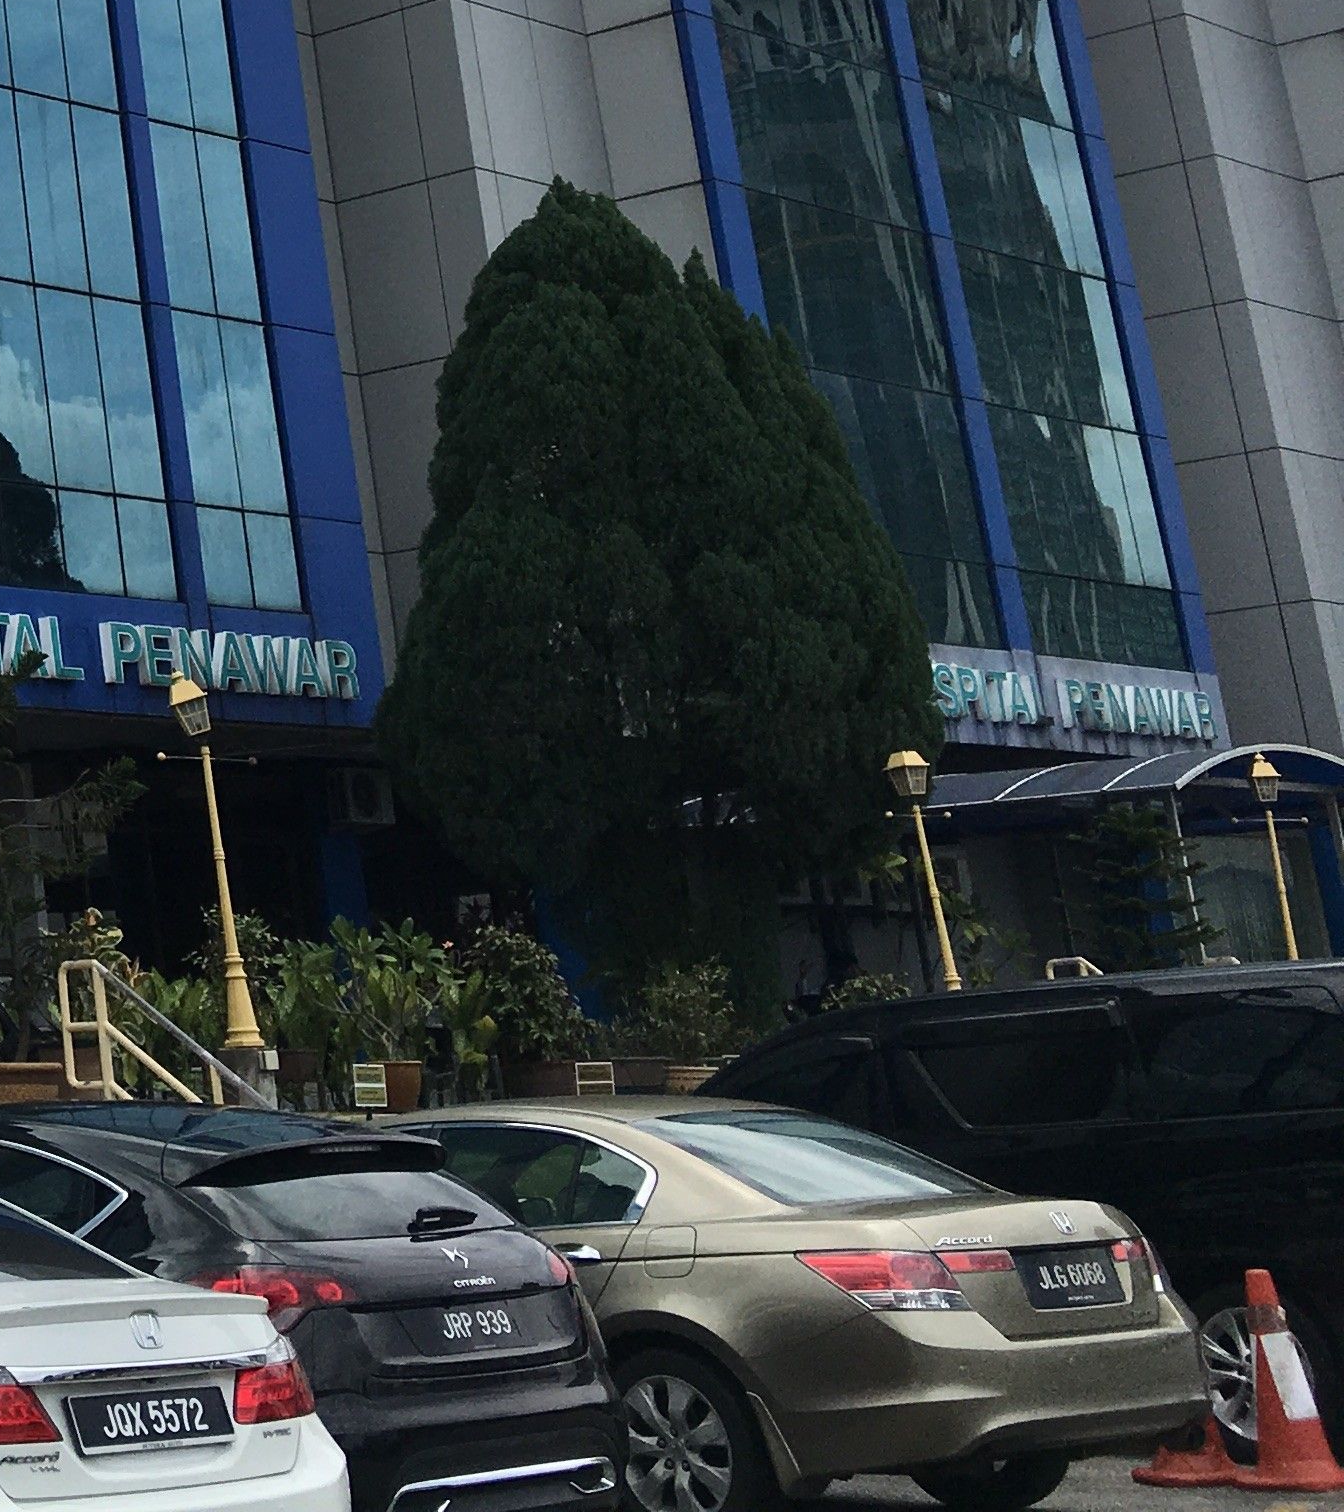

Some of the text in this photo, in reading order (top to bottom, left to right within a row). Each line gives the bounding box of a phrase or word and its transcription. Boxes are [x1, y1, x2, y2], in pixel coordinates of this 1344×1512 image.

[98, 620, 361, 700] PENAWAR
[931, 662, 1218, 739] SPITAL PENAWAR
[935, 1234, 993, 1248] Accord
[1038, 1265, 1069, 1290] JLG
[442, 1309, 512, 1339] JRP 939
[103, 1397, 210, 1439] JQX 5572
